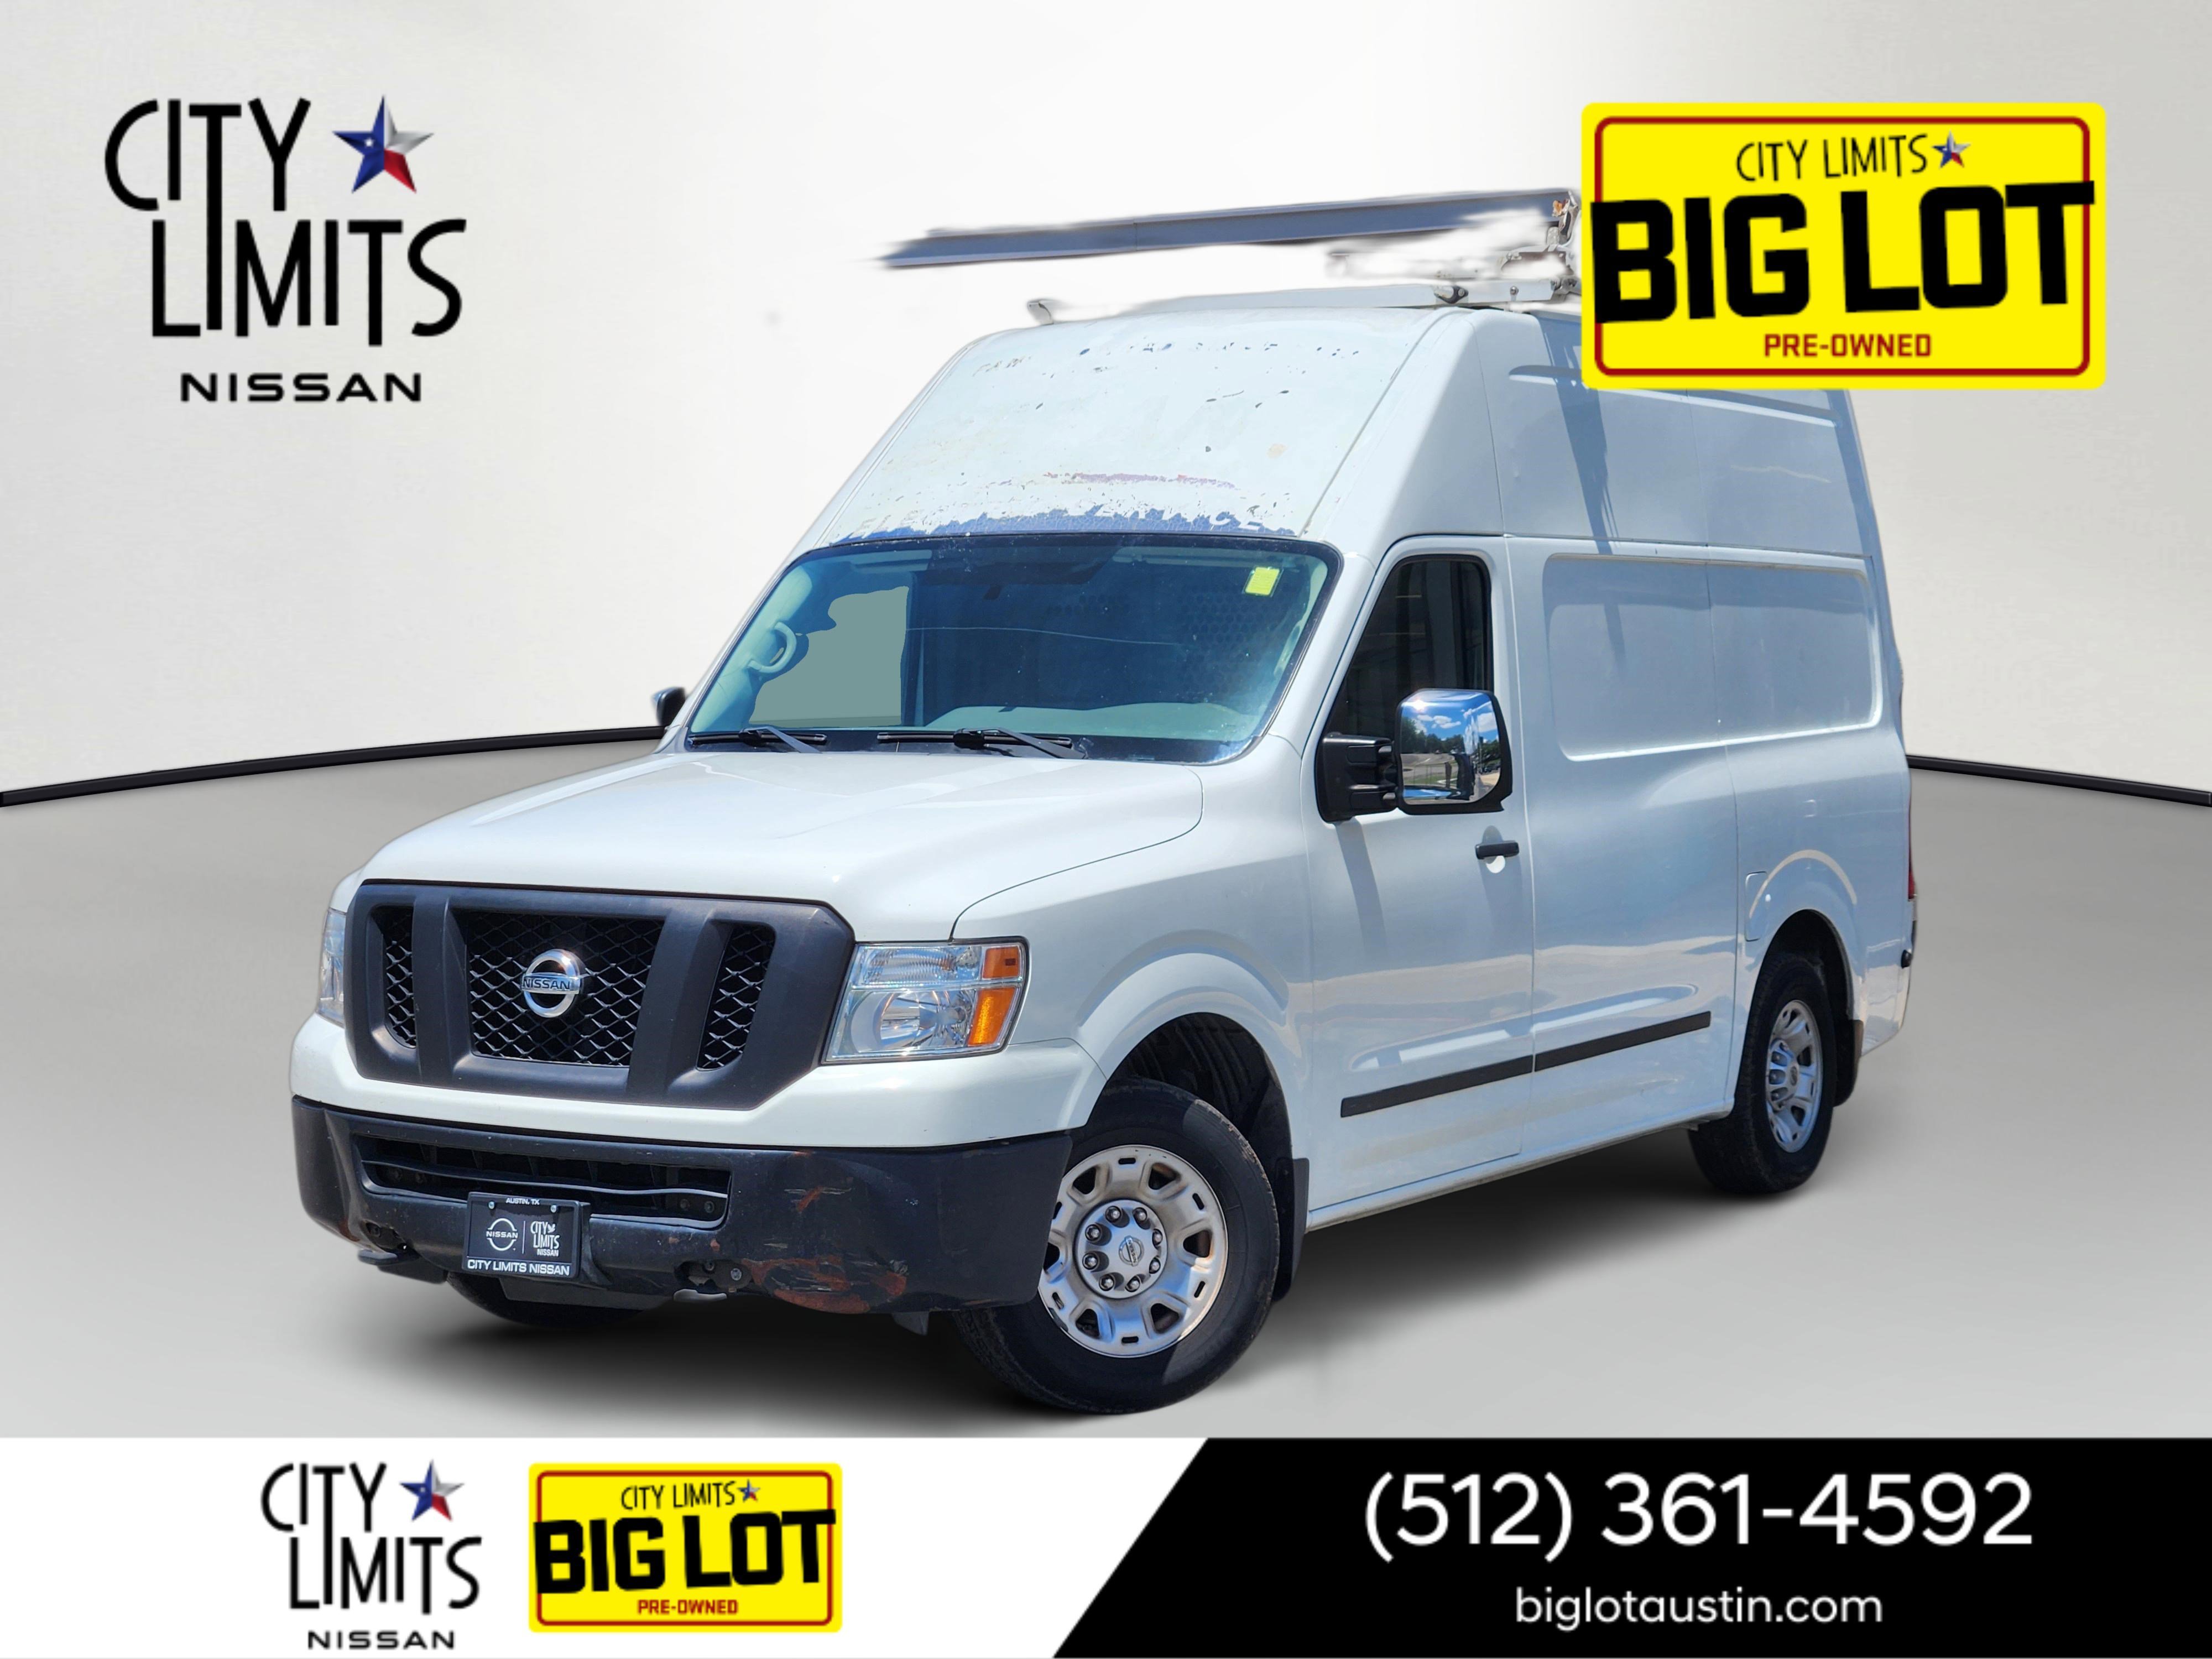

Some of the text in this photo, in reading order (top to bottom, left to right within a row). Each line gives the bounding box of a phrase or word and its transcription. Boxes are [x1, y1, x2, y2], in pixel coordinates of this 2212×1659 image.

[523, 977, 570, 990] NISSAN
[530, 1220, 548, 1235] CITY
[533, 1234, 560, 1249] LIMITS
[467, 1259, 570, 1276] CITY LIMITS NISSAN
